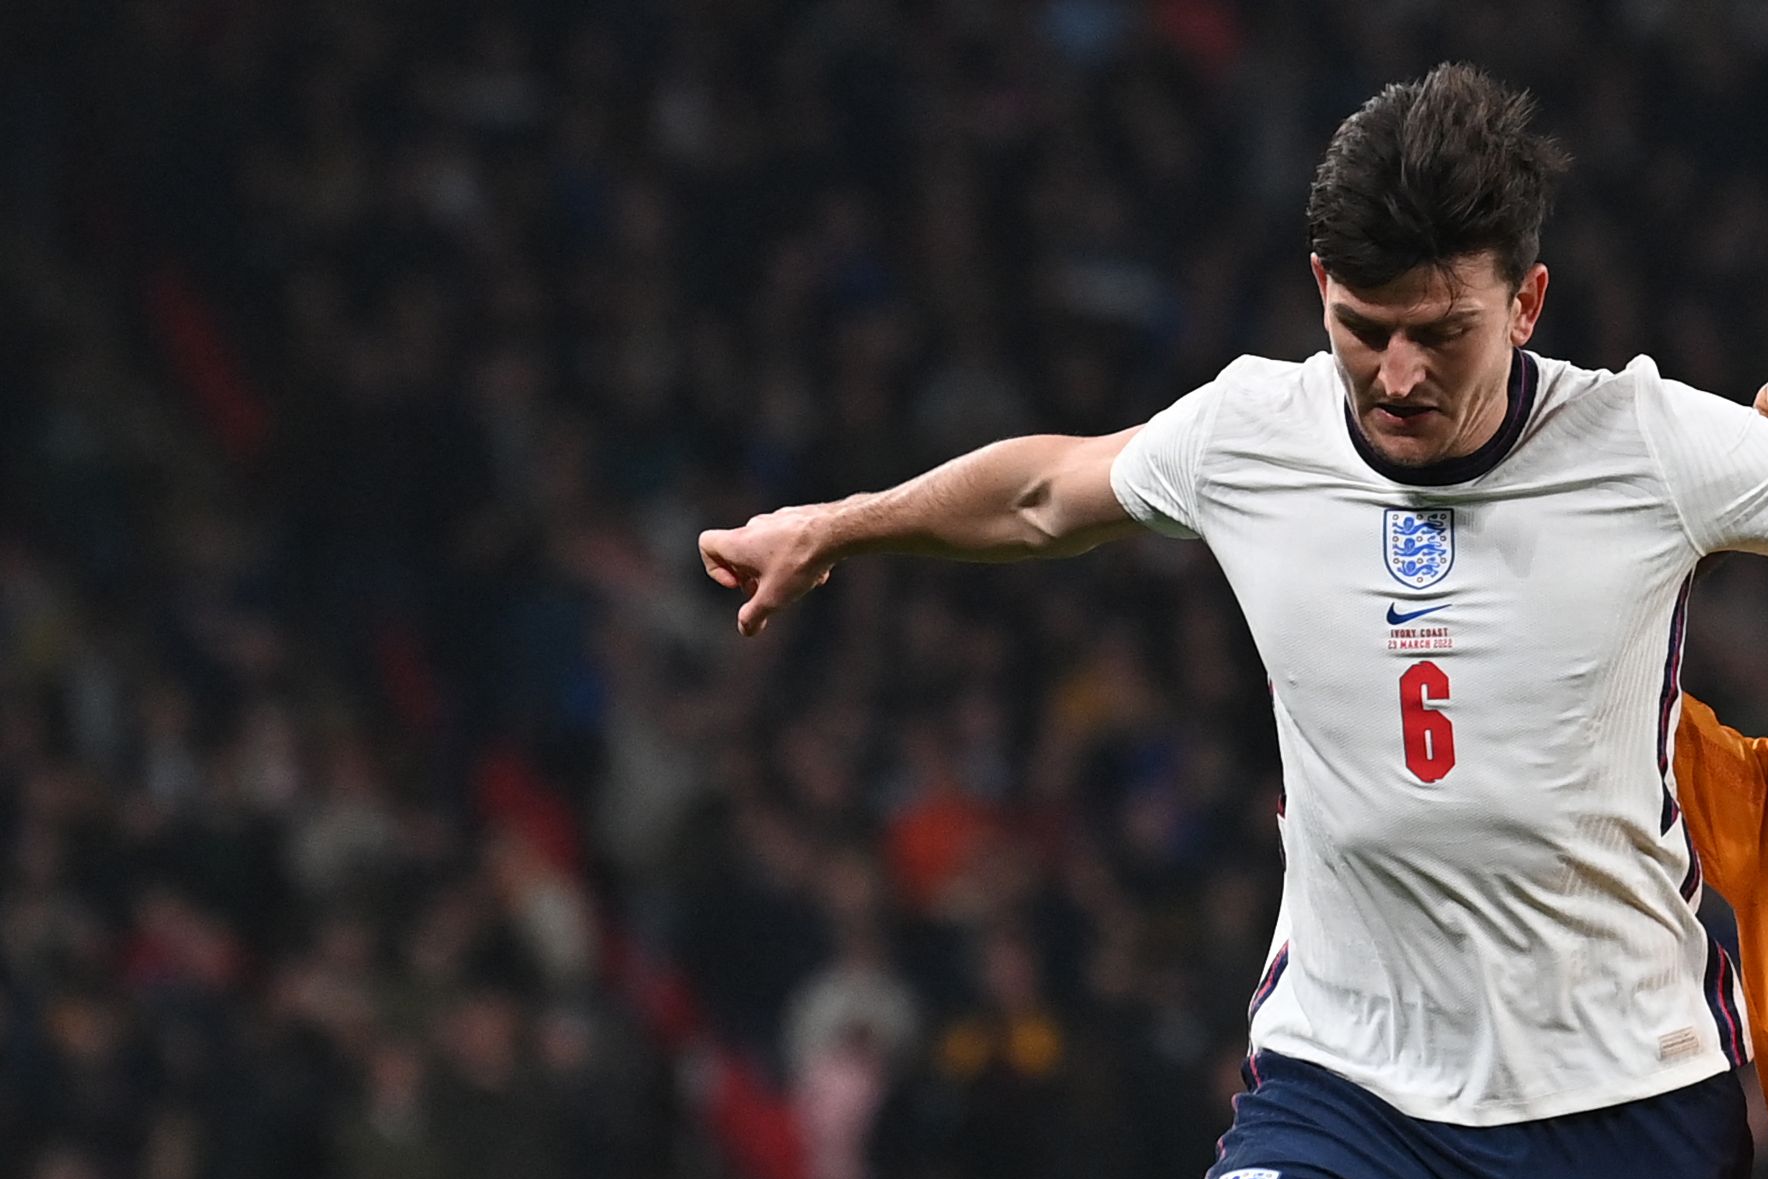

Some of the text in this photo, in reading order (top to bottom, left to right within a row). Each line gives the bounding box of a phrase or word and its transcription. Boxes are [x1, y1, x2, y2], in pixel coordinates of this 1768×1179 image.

[1390, 627, 1448, 638] IVORY COAST
[1400, 640, 1431, 649] MARCH
[1399, 660, 1456, 784] 6
